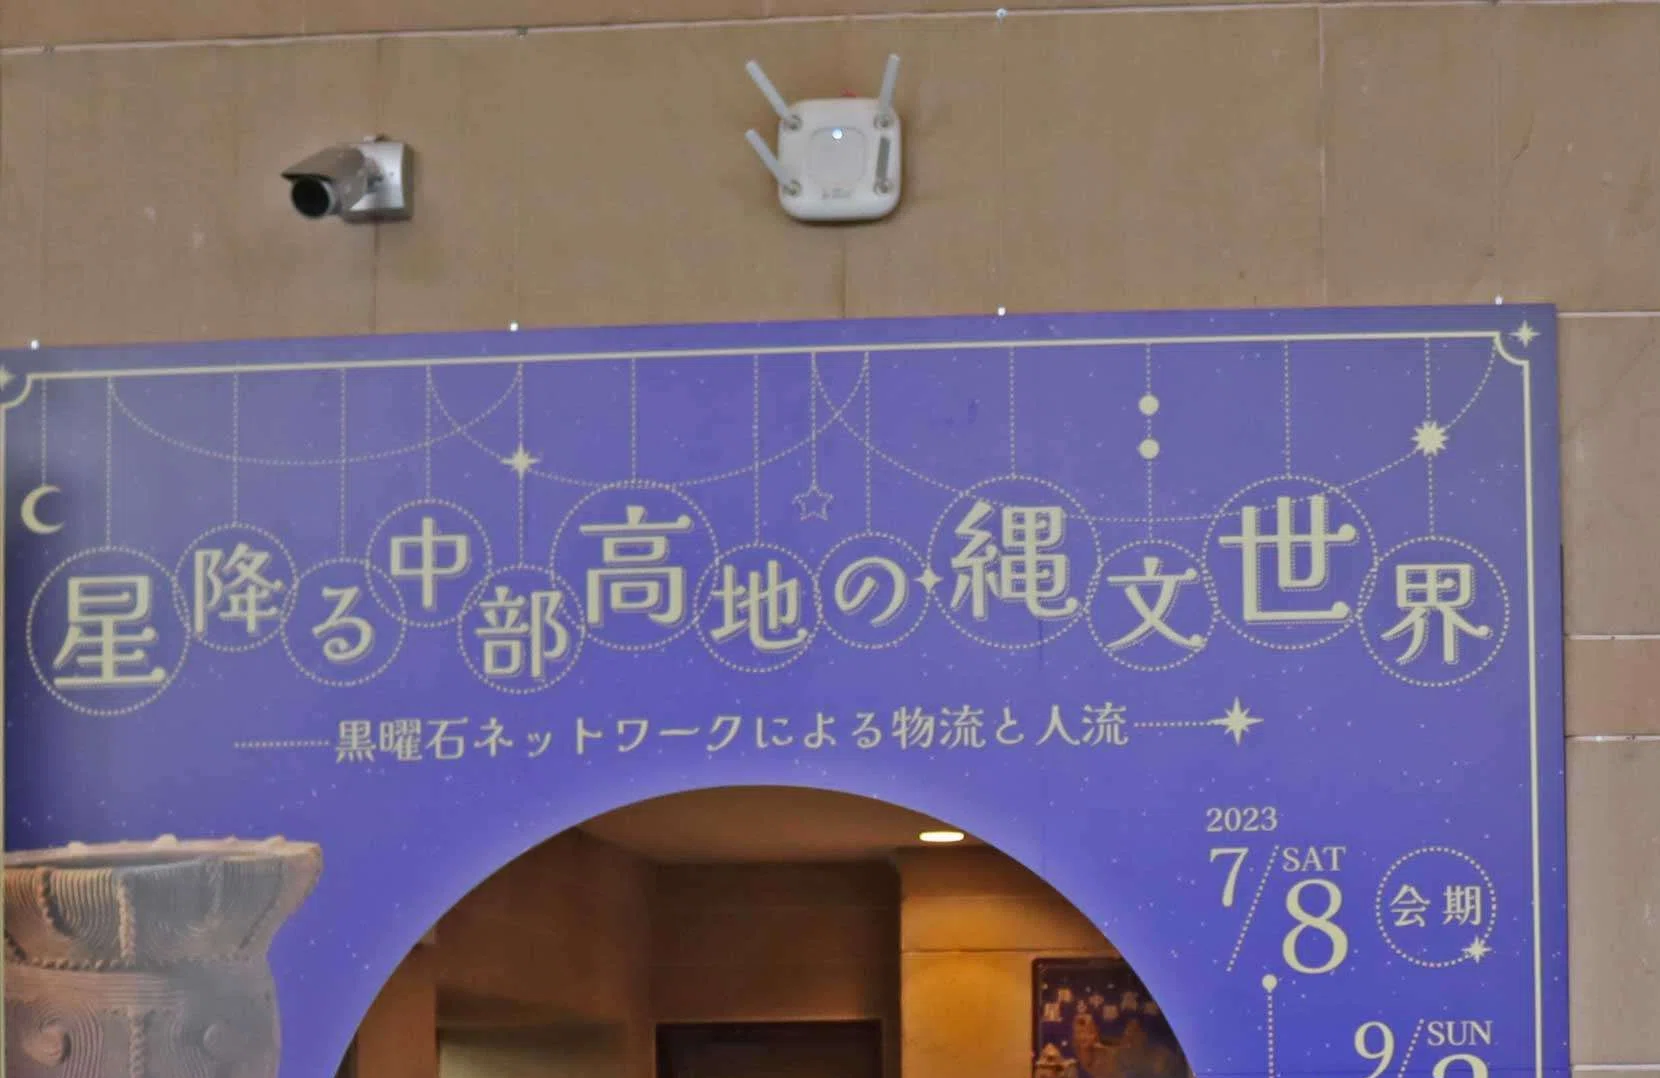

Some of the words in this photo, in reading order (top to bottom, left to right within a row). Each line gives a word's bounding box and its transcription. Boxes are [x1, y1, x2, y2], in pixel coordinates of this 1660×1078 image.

[52, 494, 1494, 690] 星降る中部高地の縄文世界
[334, 702, 1130, 764] 黒曜石ネットワークによる物流と人流
[1206, 806, 1278, 833] 2023
[1282, 845, 1346, 873] SAT
[1389, 884, 1482, 928] 会期
[1427, 1020, 1493, 1046] SUN
